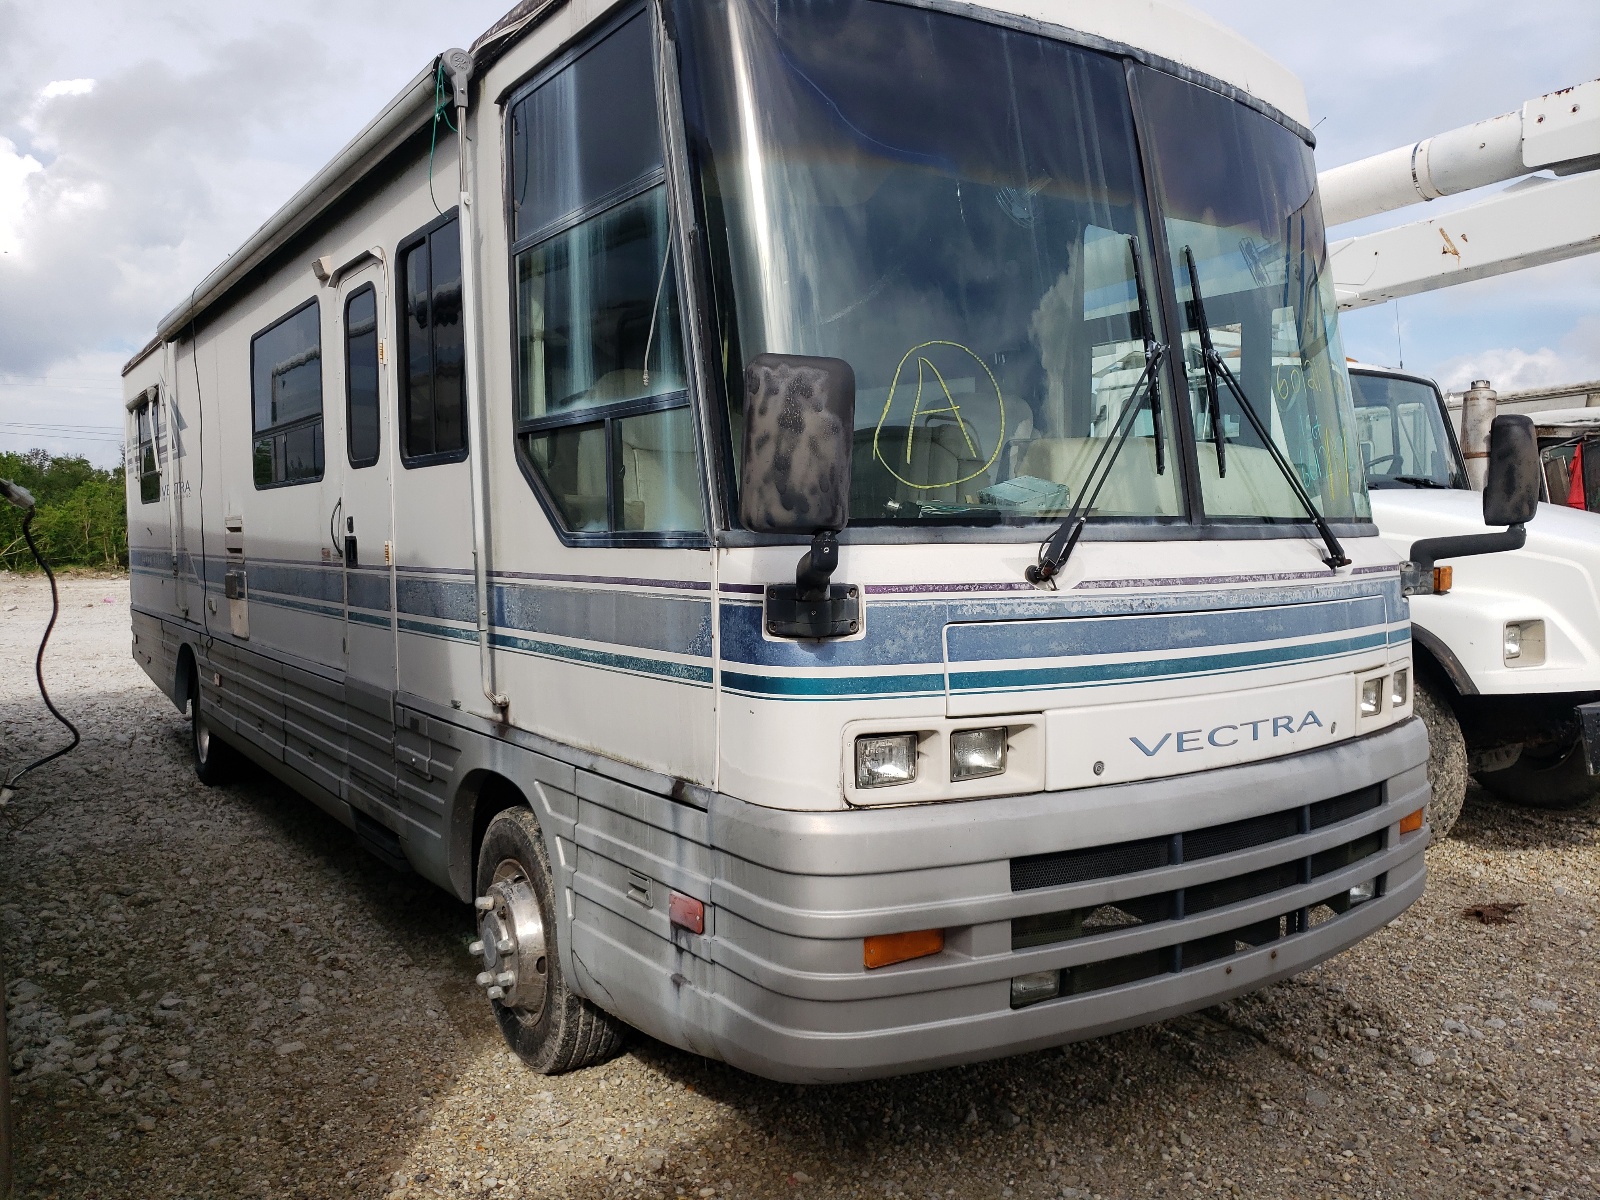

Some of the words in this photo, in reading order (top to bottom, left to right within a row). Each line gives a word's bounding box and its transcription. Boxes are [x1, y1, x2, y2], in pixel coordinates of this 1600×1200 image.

[906, 357, 977, 465] A
[161, 480, 191, 496] VETRA
[1129, 710, 1323, 757] VECTRA
